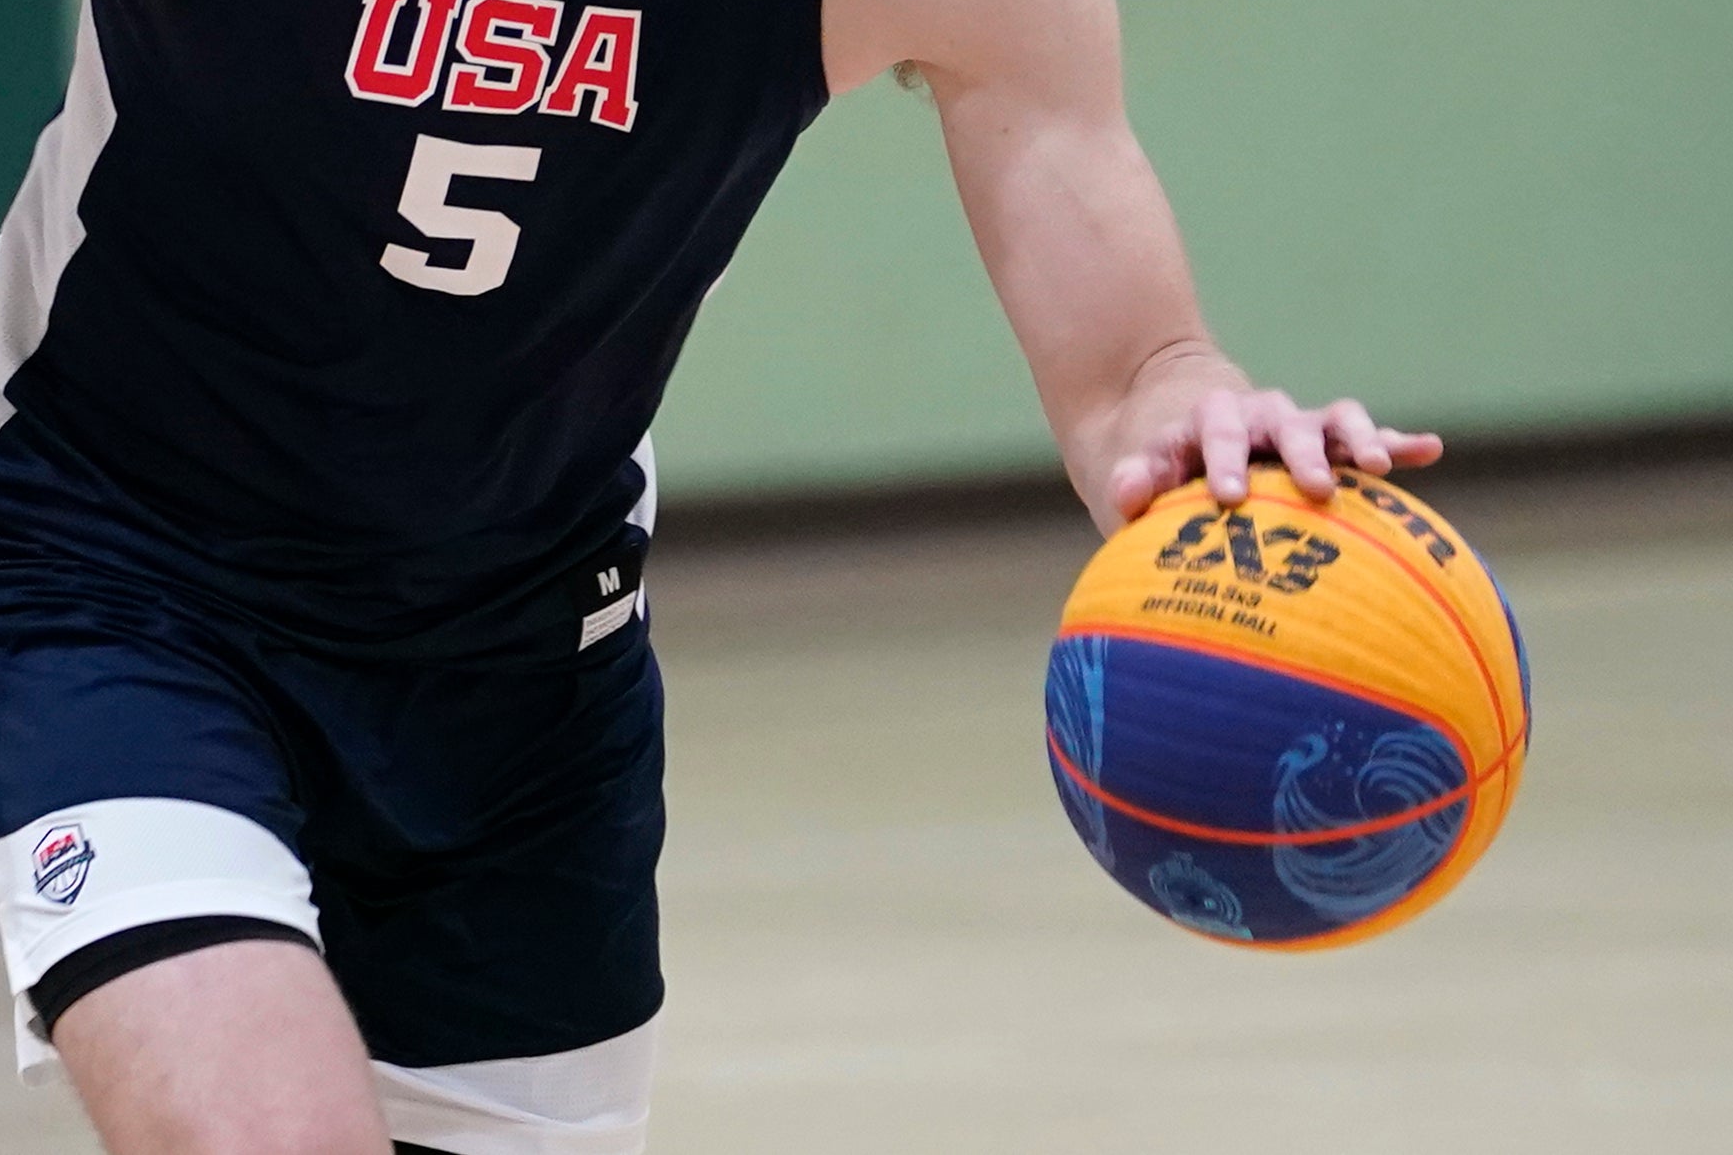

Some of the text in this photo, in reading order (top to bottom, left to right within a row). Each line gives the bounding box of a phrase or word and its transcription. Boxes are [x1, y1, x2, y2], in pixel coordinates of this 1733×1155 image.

[379, 133, 542, 296] 5
[596, 566, 621, 596] M
[1172, 577, 1219, 597] FIBA
[1141, 596, 1278, 637] OFFICIAL BALL
